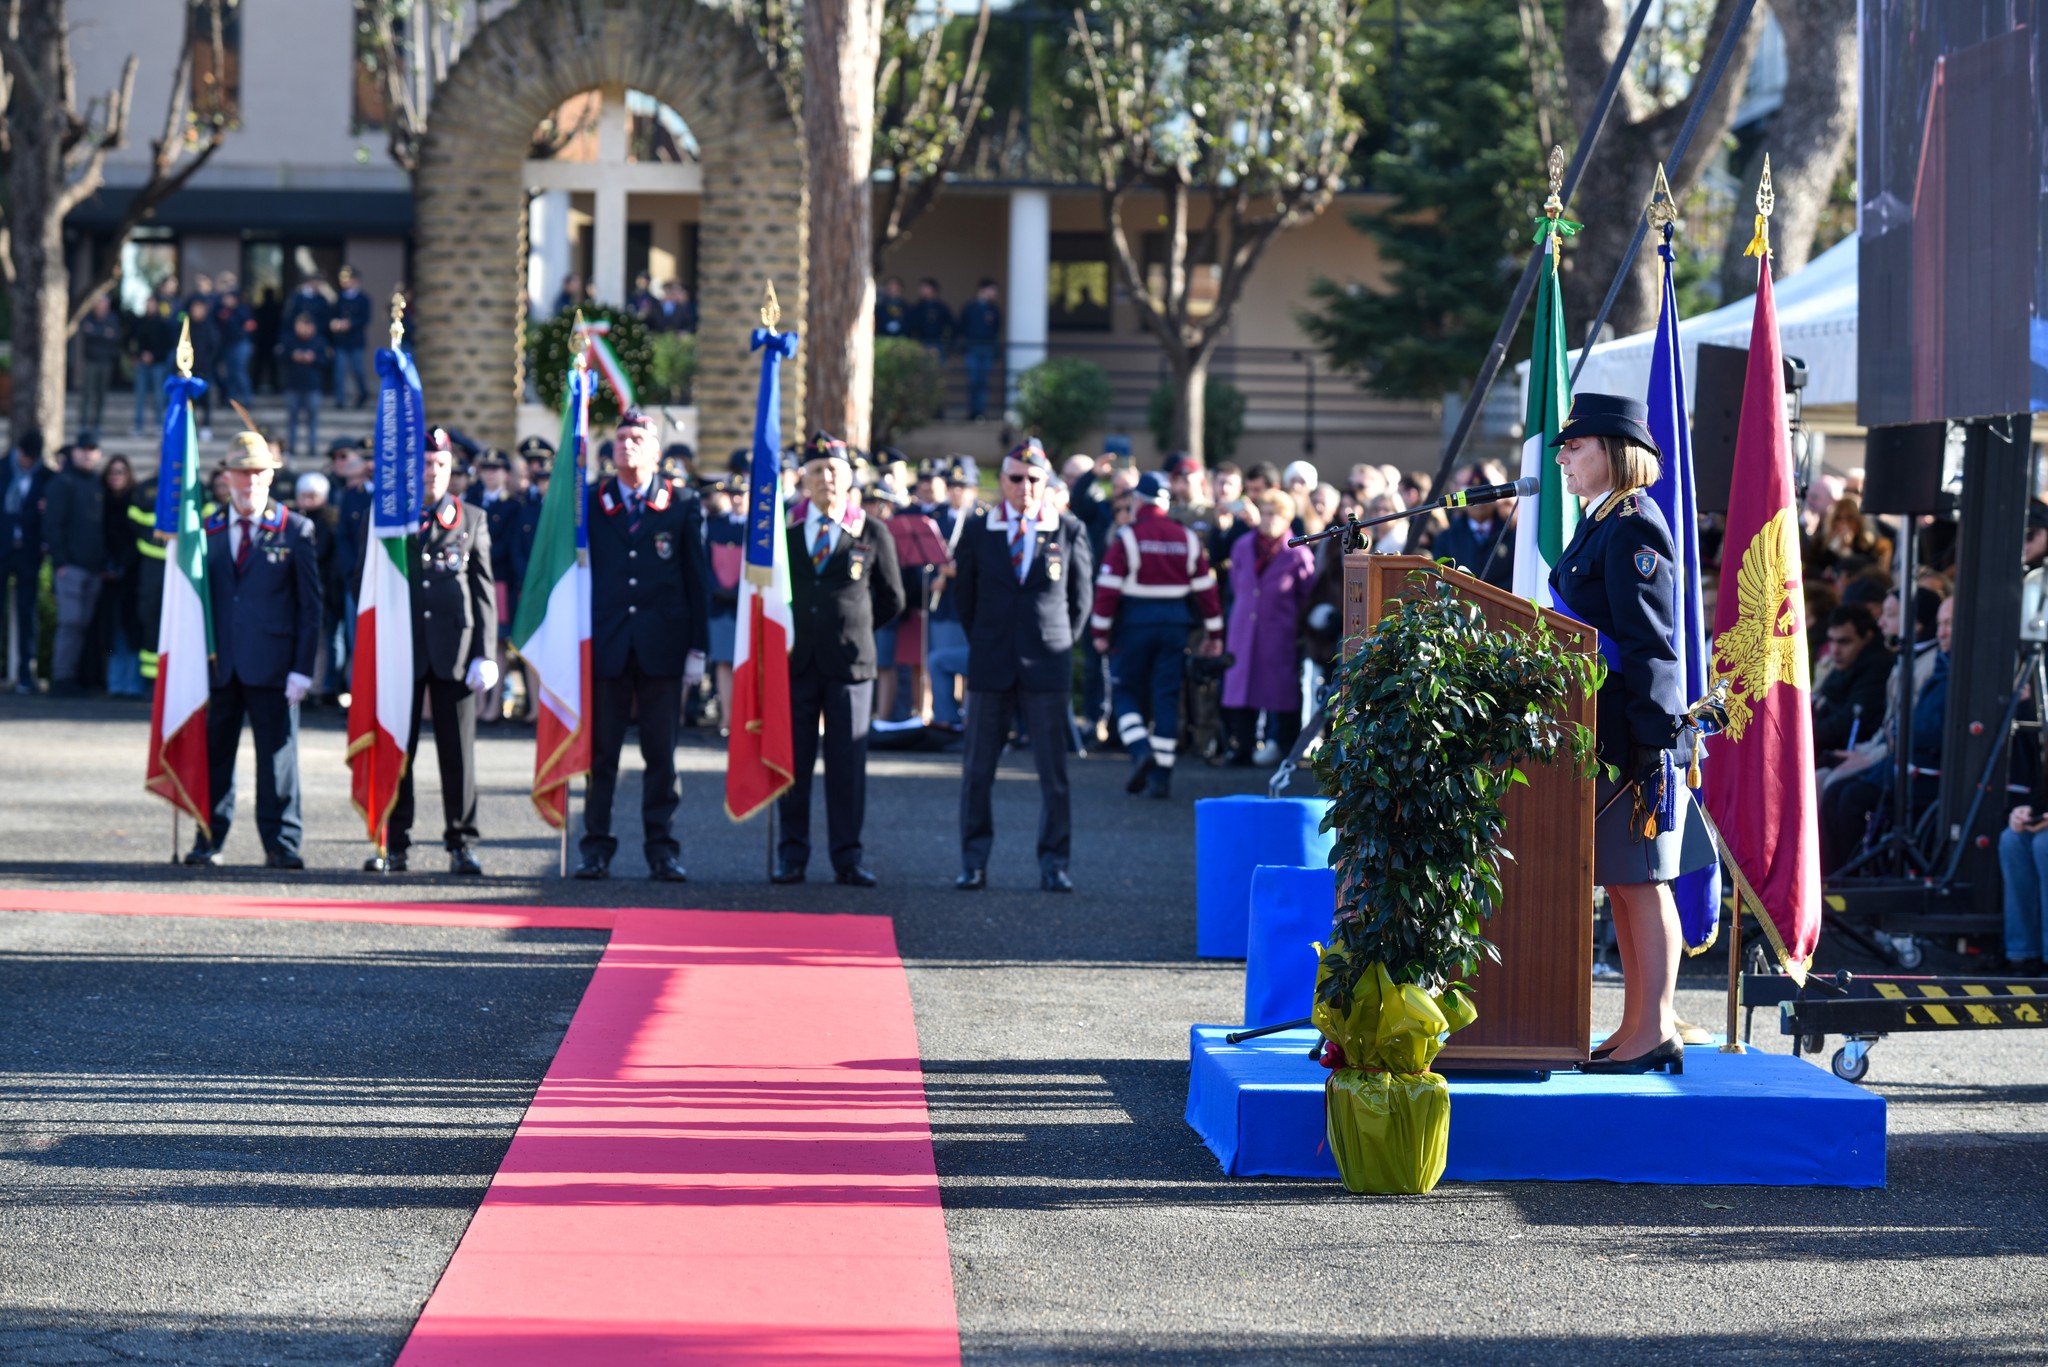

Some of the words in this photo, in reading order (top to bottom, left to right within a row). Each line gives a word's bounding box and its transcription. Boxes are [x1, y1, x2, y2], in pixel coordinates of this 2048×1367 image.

[382, 389, 397, 461] CARABINIERI
[382, 463, 398, 490] NAZ.
[382, 492, 398, 517] ASS.
